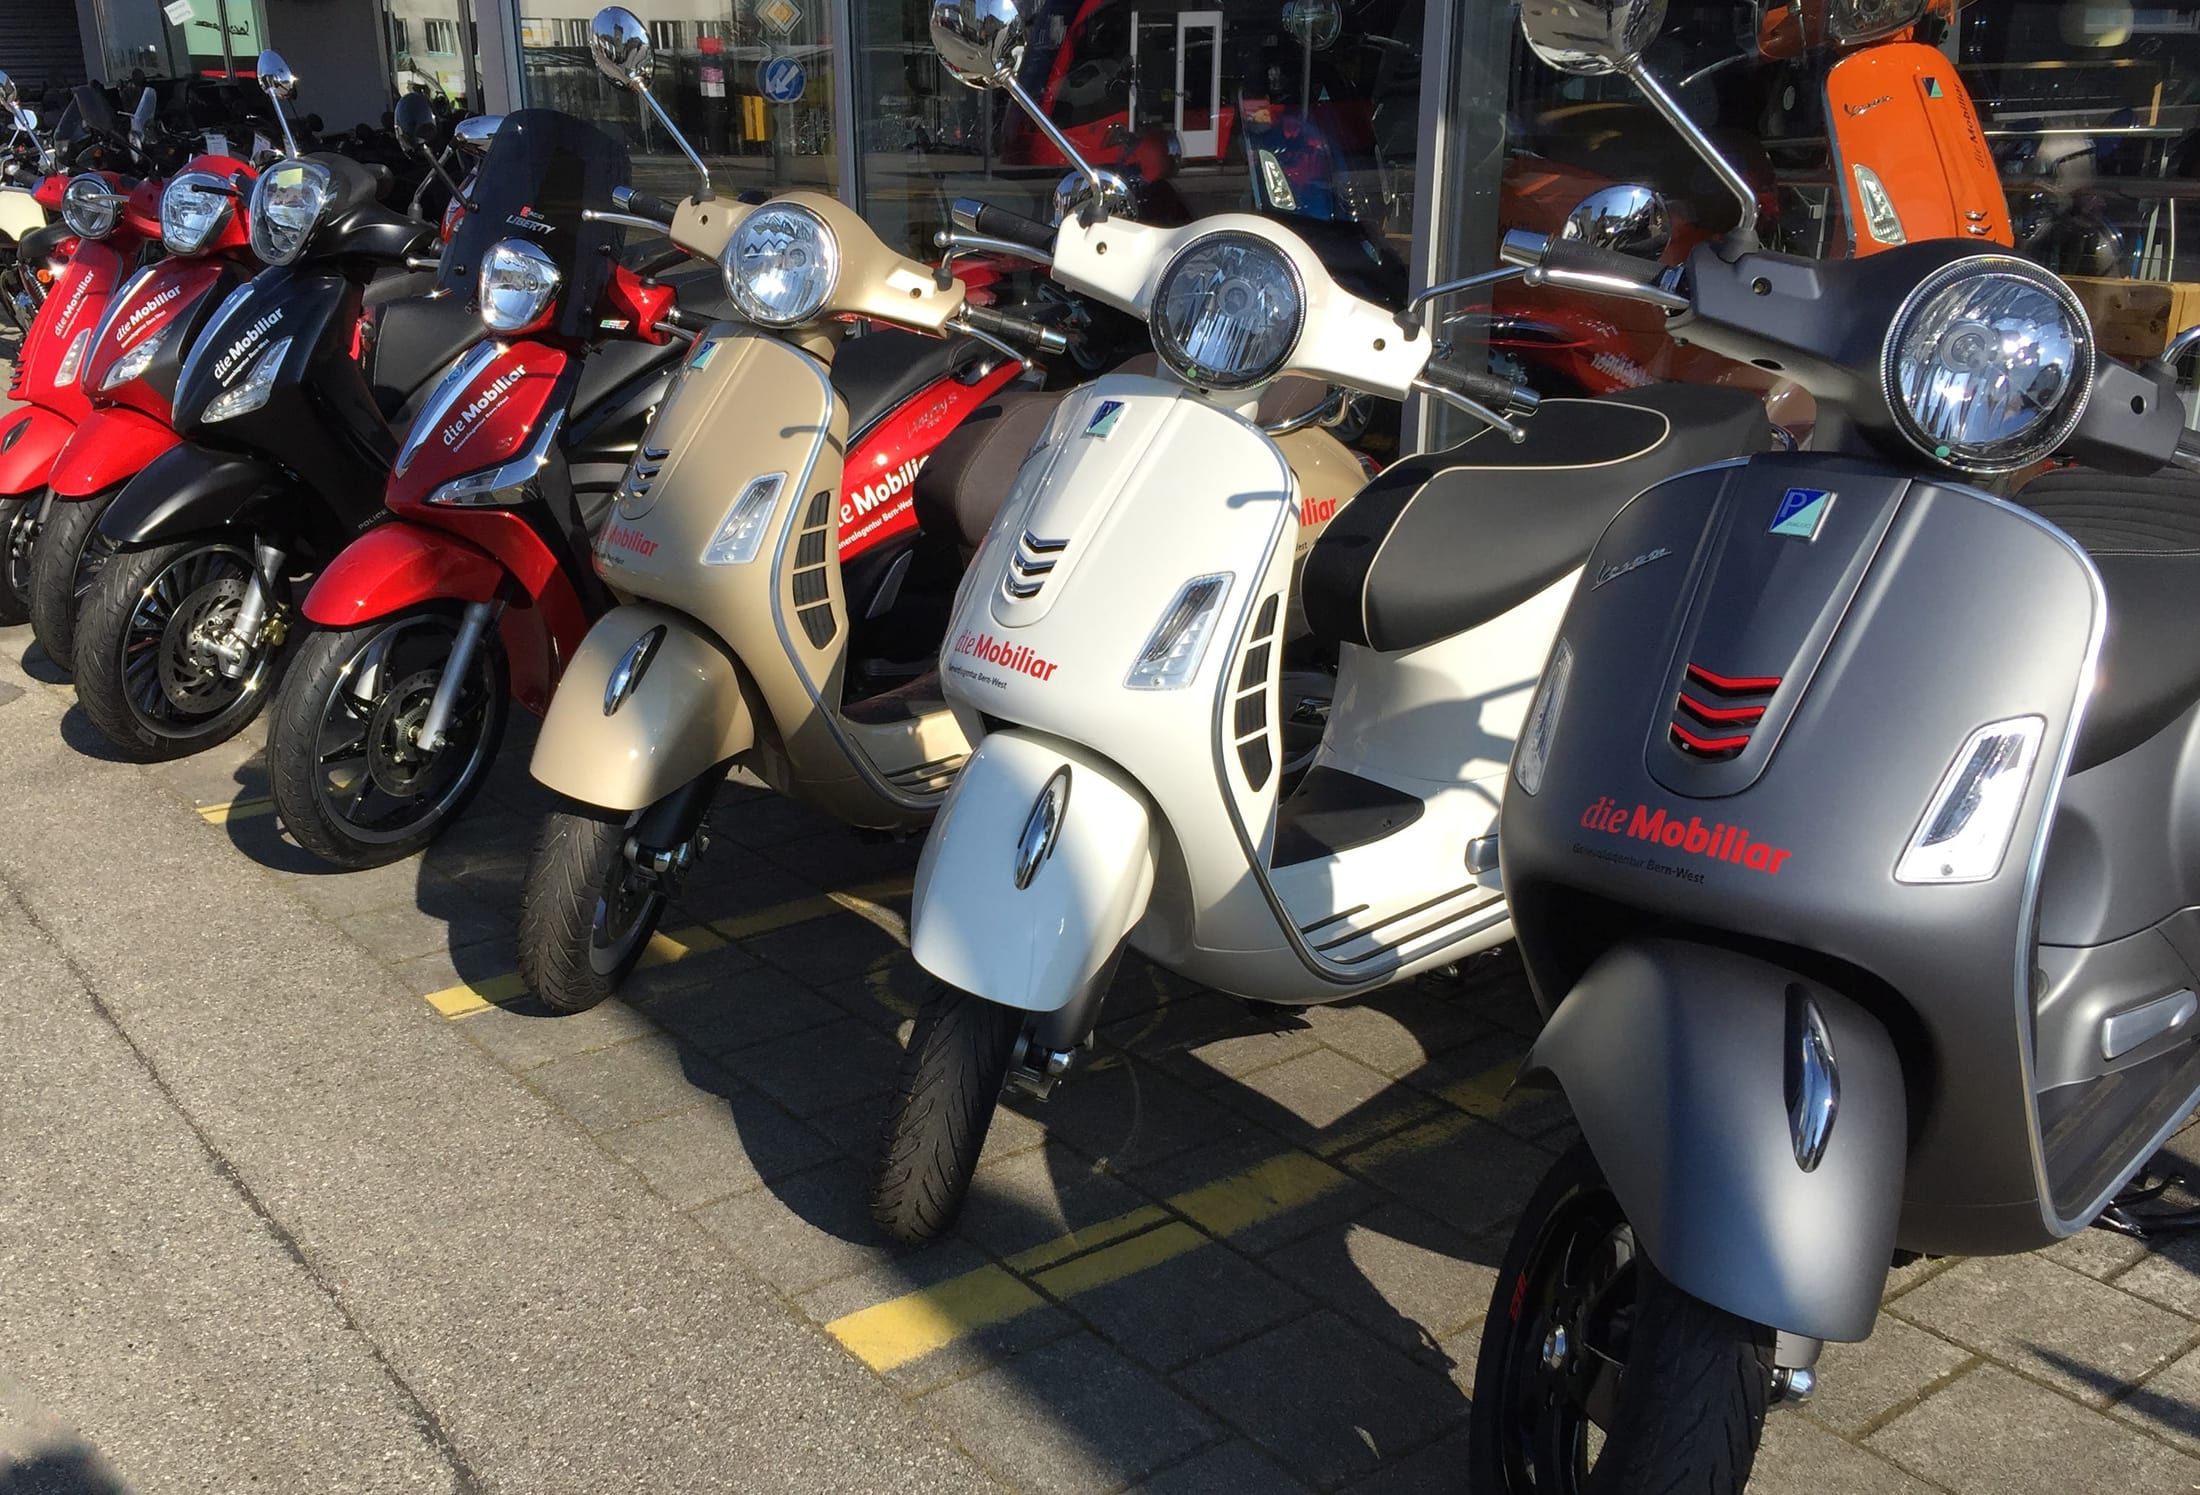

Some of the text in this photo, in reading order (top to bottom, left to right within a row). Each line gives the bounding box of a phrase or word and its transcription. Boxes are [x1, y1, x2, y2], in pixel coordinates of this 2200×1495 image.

[505, 214, 557, 235] LIBERTY
[55, 317, 67, 336] die
[62, 270, 95, 318] Mobiliar
[116, 322, 131, 341] die
[129, 285, 181, 325] Mobiliar
[214, 307, 284, 380] die Mobiliar
[443, 364, 527, 446] die Mobiliar
[851, 454, 930, 516] Mobili
[1300, 497, 1337, 527] iliar
[358, 508, 389, 530] POLICE
[1591, 547, 1673, 591] Vespa
[955, 629, 1058, 681] die Mobiliar
[1580, 796, 1792, 875] die Mobiliar
[1646, 860, 1705, 884] Bern-West
